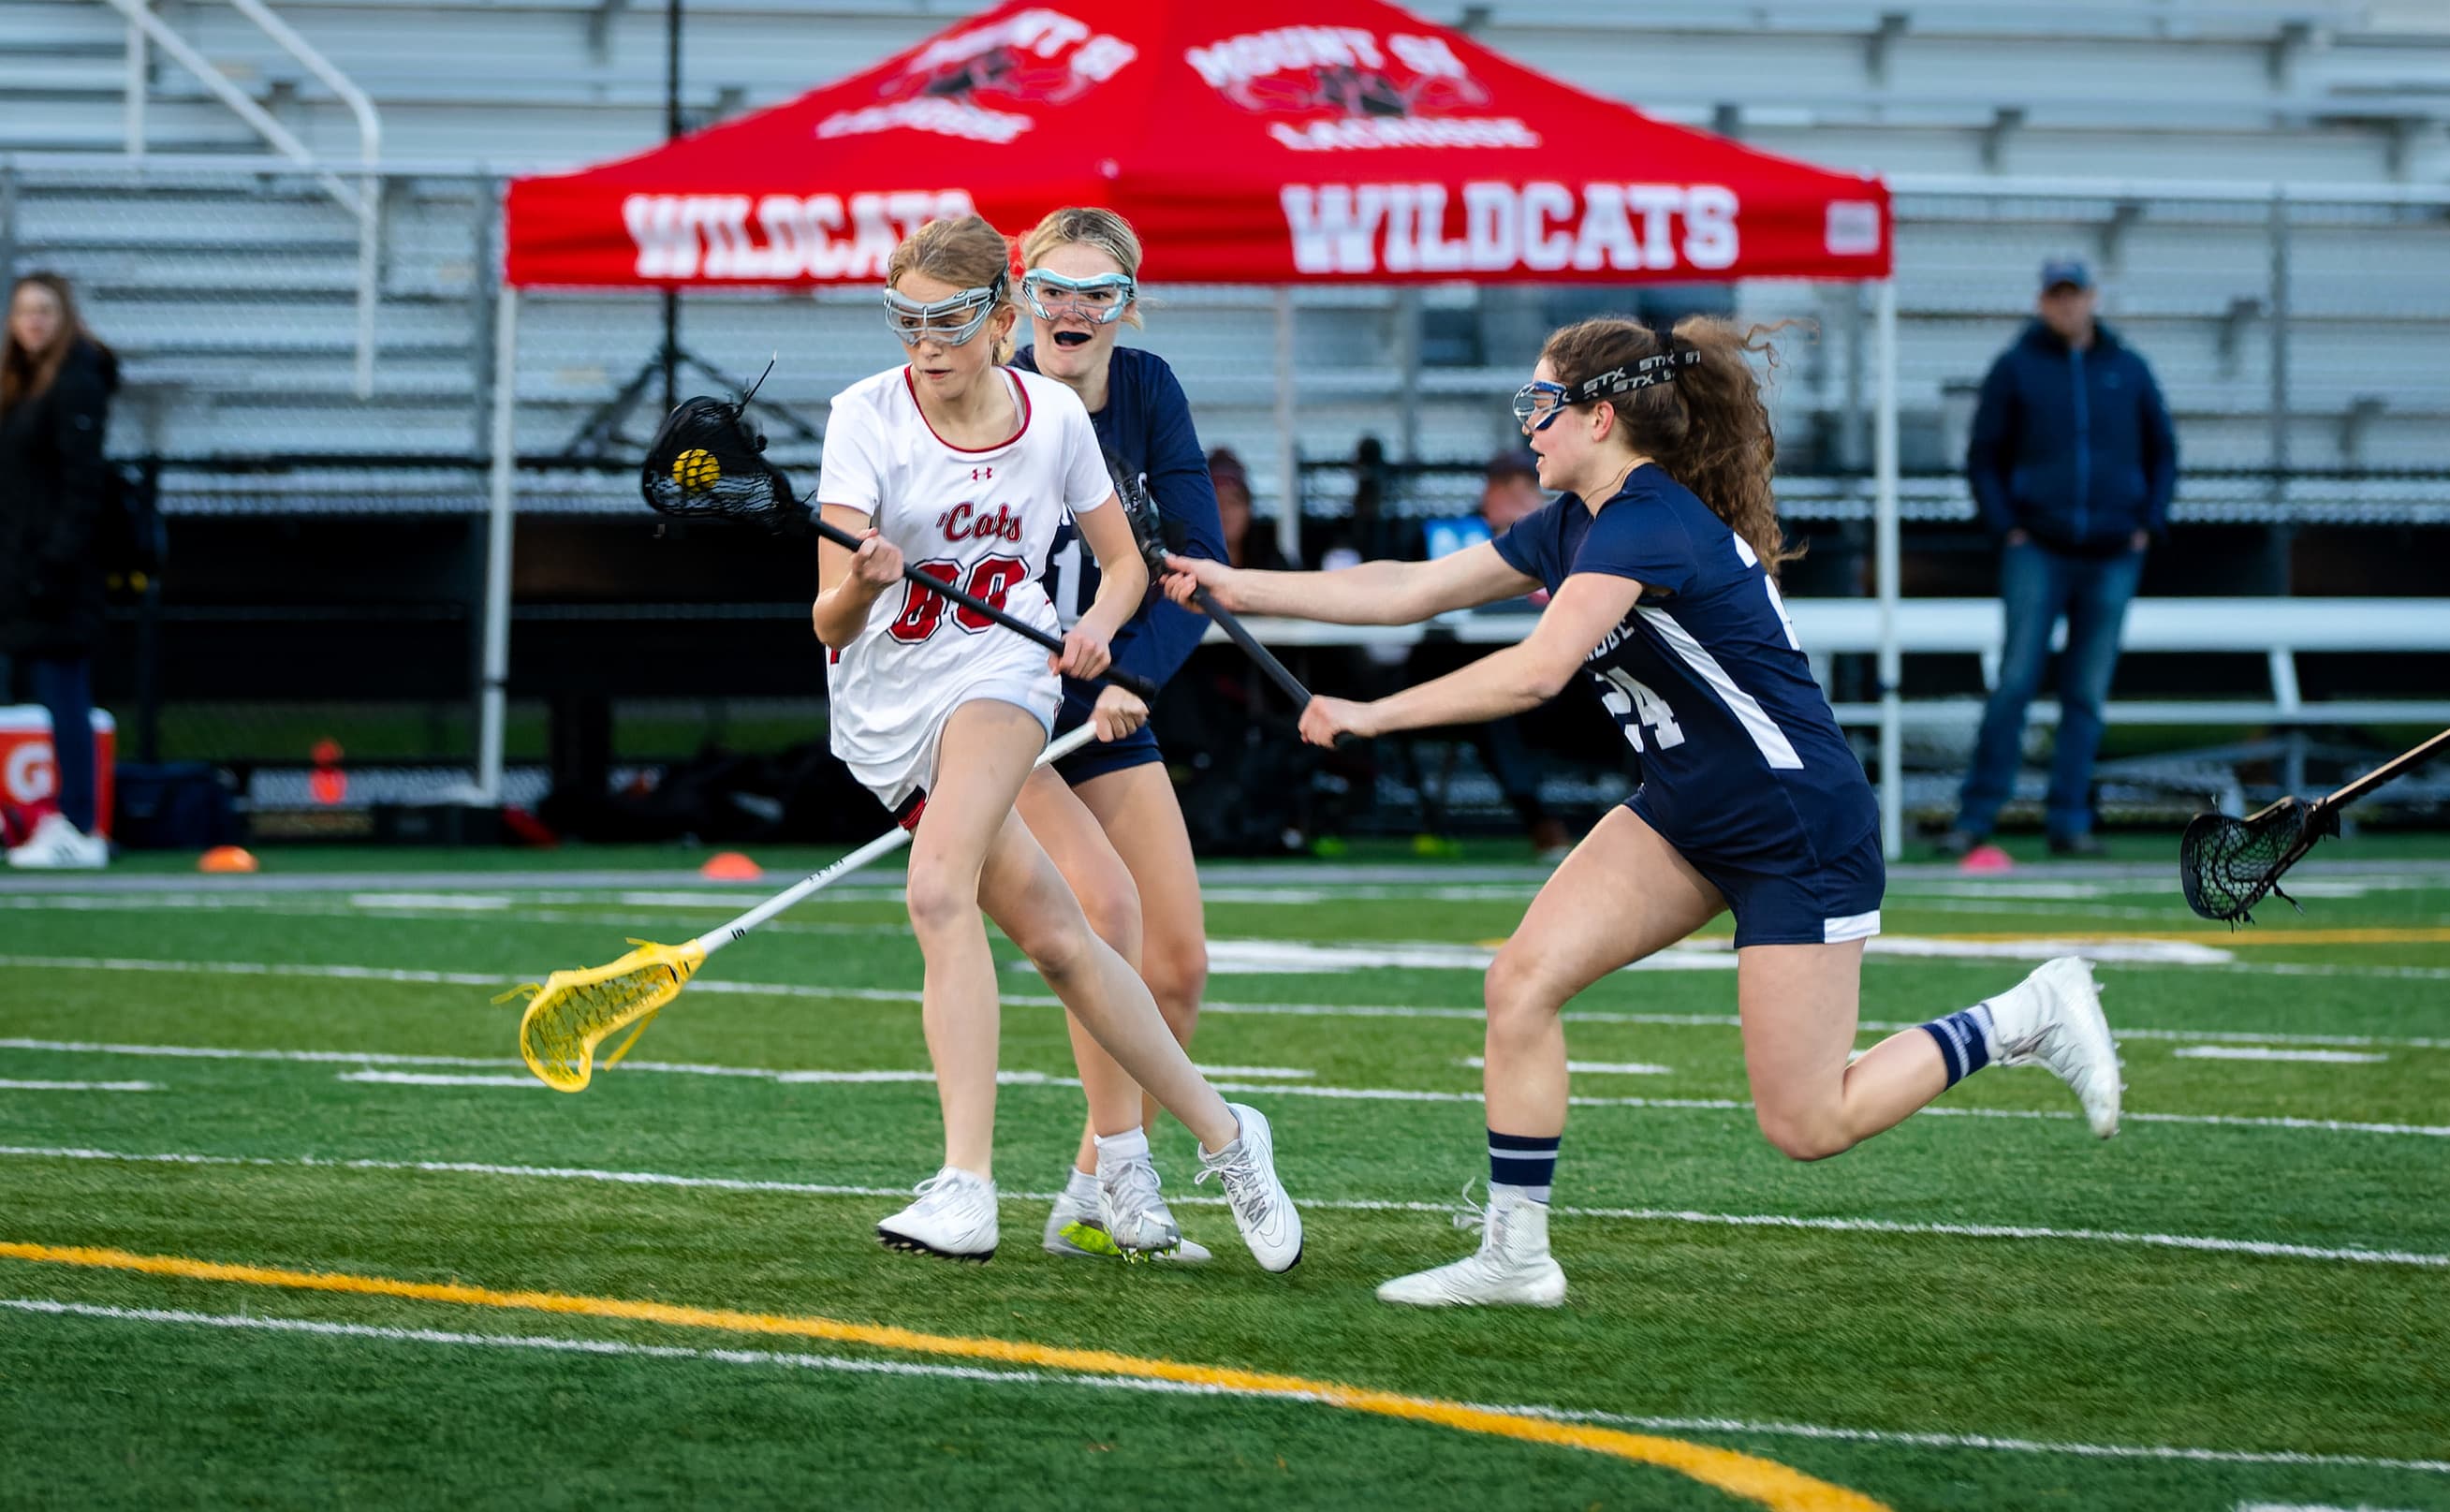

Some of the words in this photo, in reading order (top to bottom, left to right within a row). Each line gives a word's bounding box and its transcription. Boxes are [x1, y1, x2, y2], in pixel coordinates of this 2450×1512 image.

[624, 190, 976, 278] WILDCAT
[1280, 183, 1741, 274] WILDCATS
[1583, 367, 1626, 394] STX
[1612, 373, 1655, 393] STX
[6, 741, 54, 803] G
